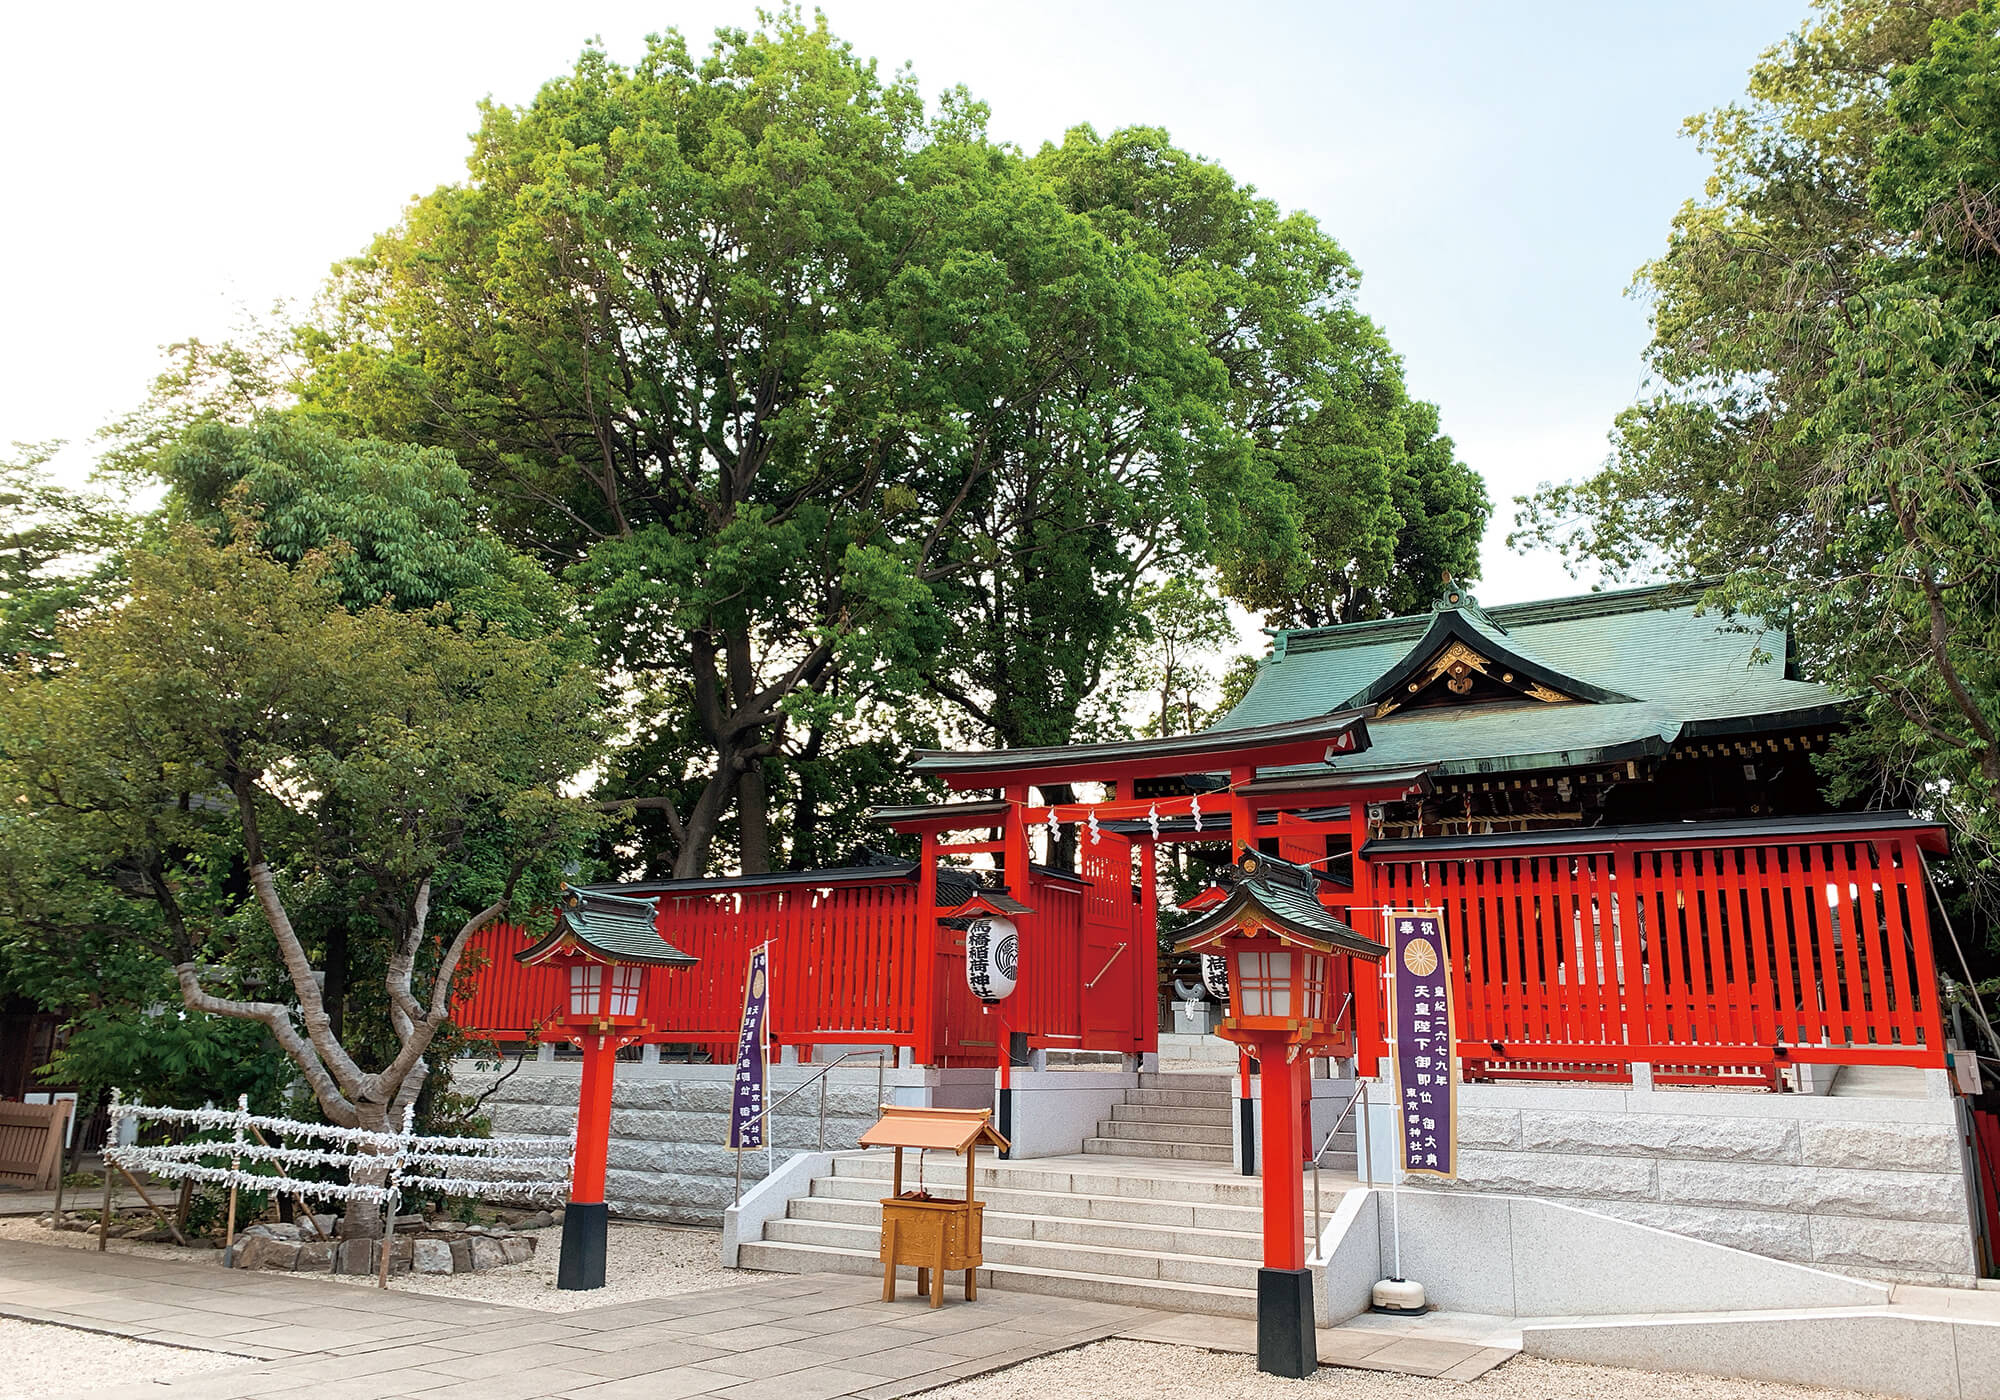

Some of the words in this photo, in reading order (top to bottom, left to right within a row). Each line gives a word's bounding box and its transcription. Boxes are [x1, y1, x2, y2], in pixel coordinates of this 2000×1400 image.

[969, 919, 997, 998] 馬橋稲荷神社
[1399, 920, 1435, 936] 奉祝
[1414, 985, 1432, 1104] 天皇陛下御即位
[1433, 985, 1448, 1087] 皇紀二六七九年
[1406, 1087, 1423, 1165] 東京都神社庁
[1422, 1117, 1438, 1167] 御大典
